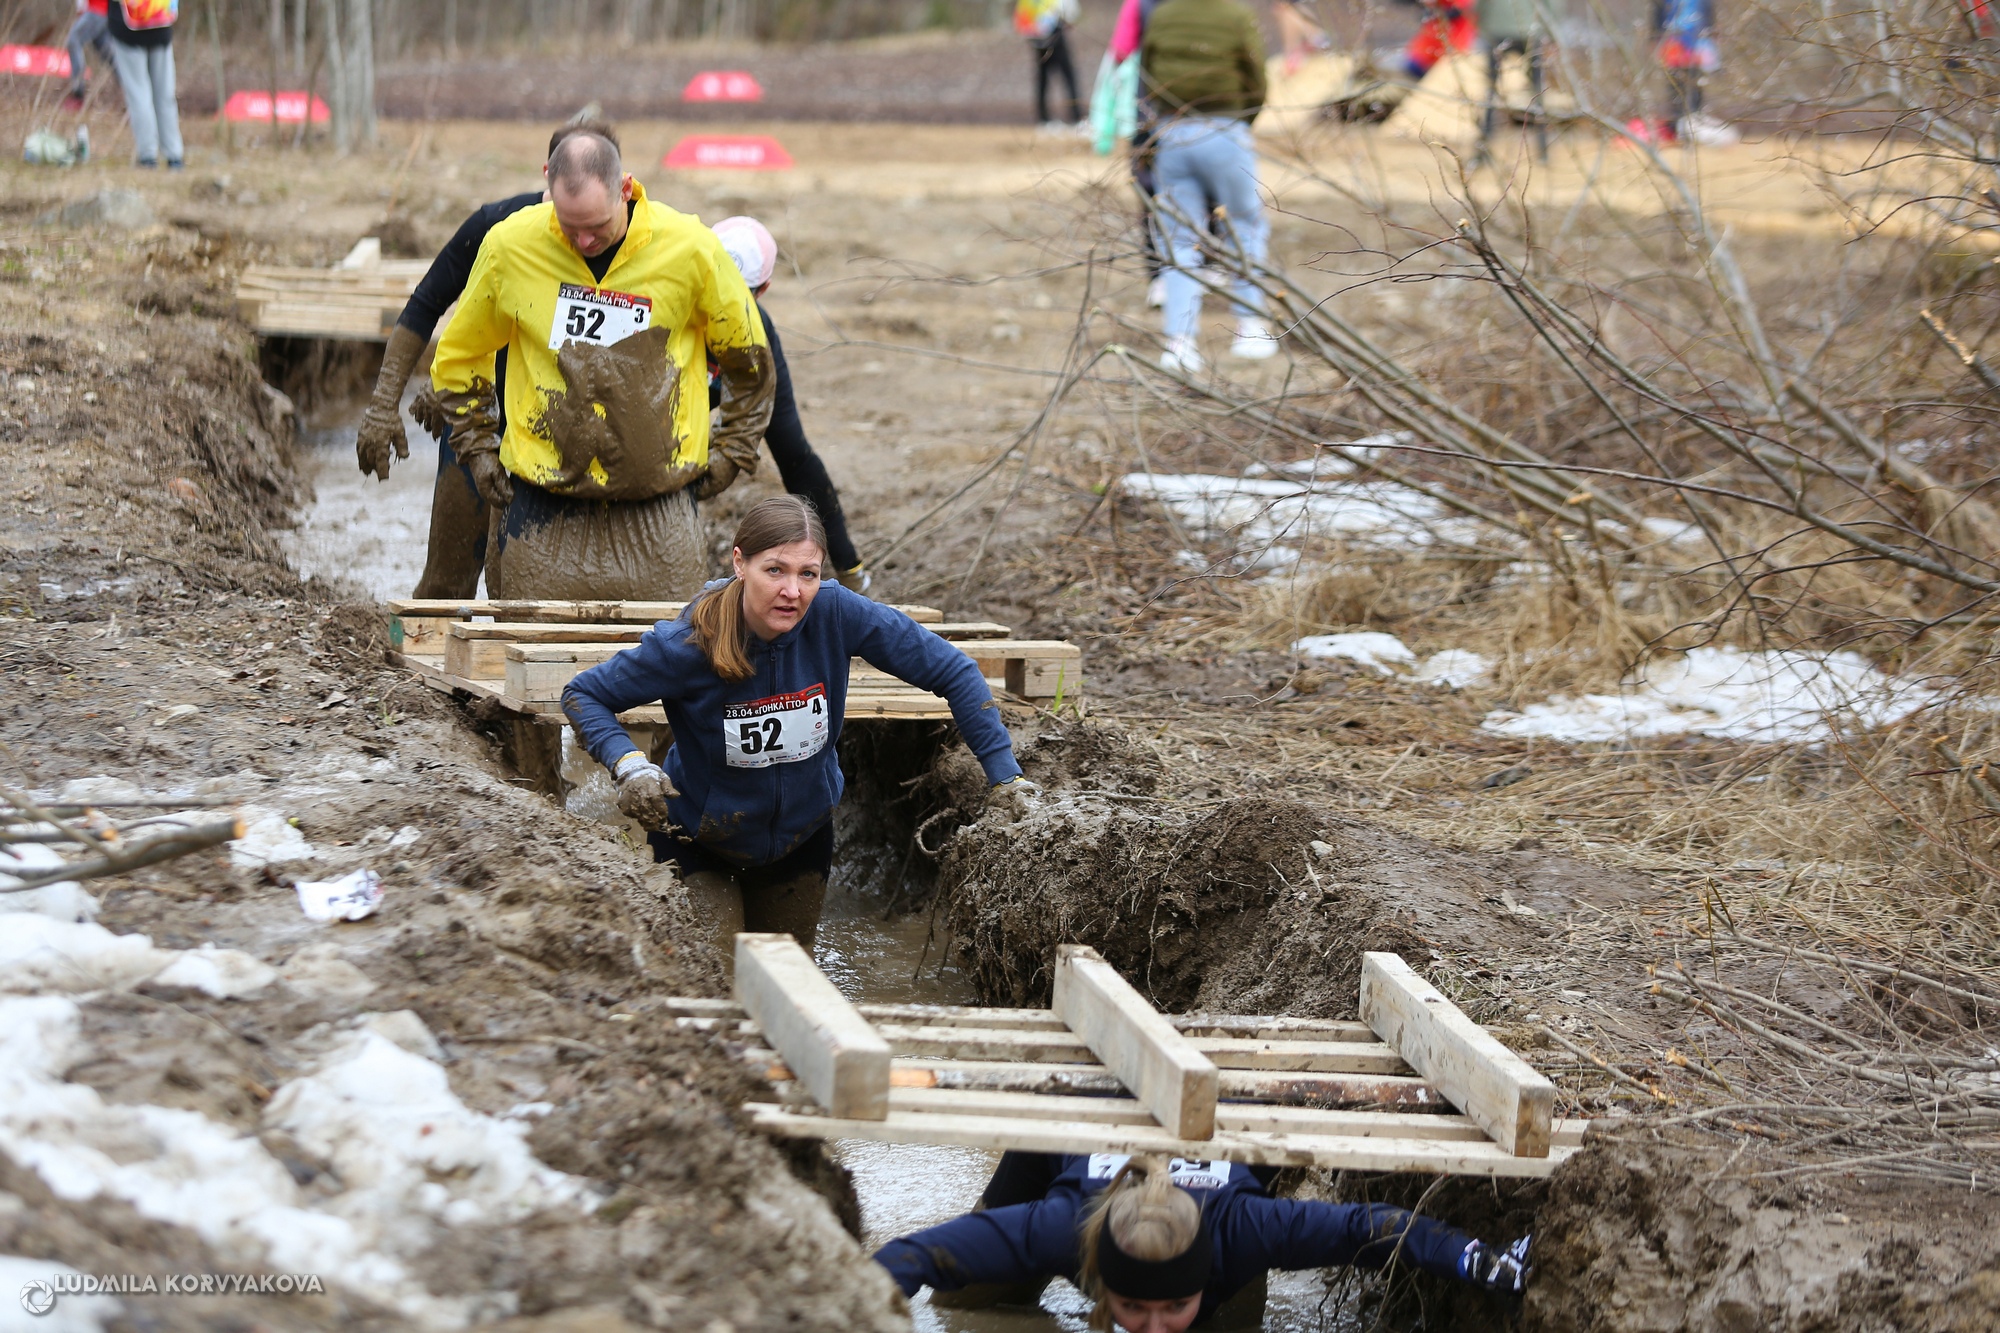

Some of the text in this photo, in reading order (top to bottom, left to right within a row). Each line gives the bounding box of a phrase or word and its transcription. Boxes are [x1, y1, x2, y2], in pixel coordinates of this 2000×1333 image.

[561, 288, 584, 299] 28.04
[566, 304, 605, 340] 52
[634, 308, 645, 323] 3
[726, 708, 753, 718] 28.04
[754, 703, 785, 715] «ГОНКА
[785, 699, 806, 710] ГТО»
[812, 697, 823, 716] 4
[740, 717, 783, 755] 52
